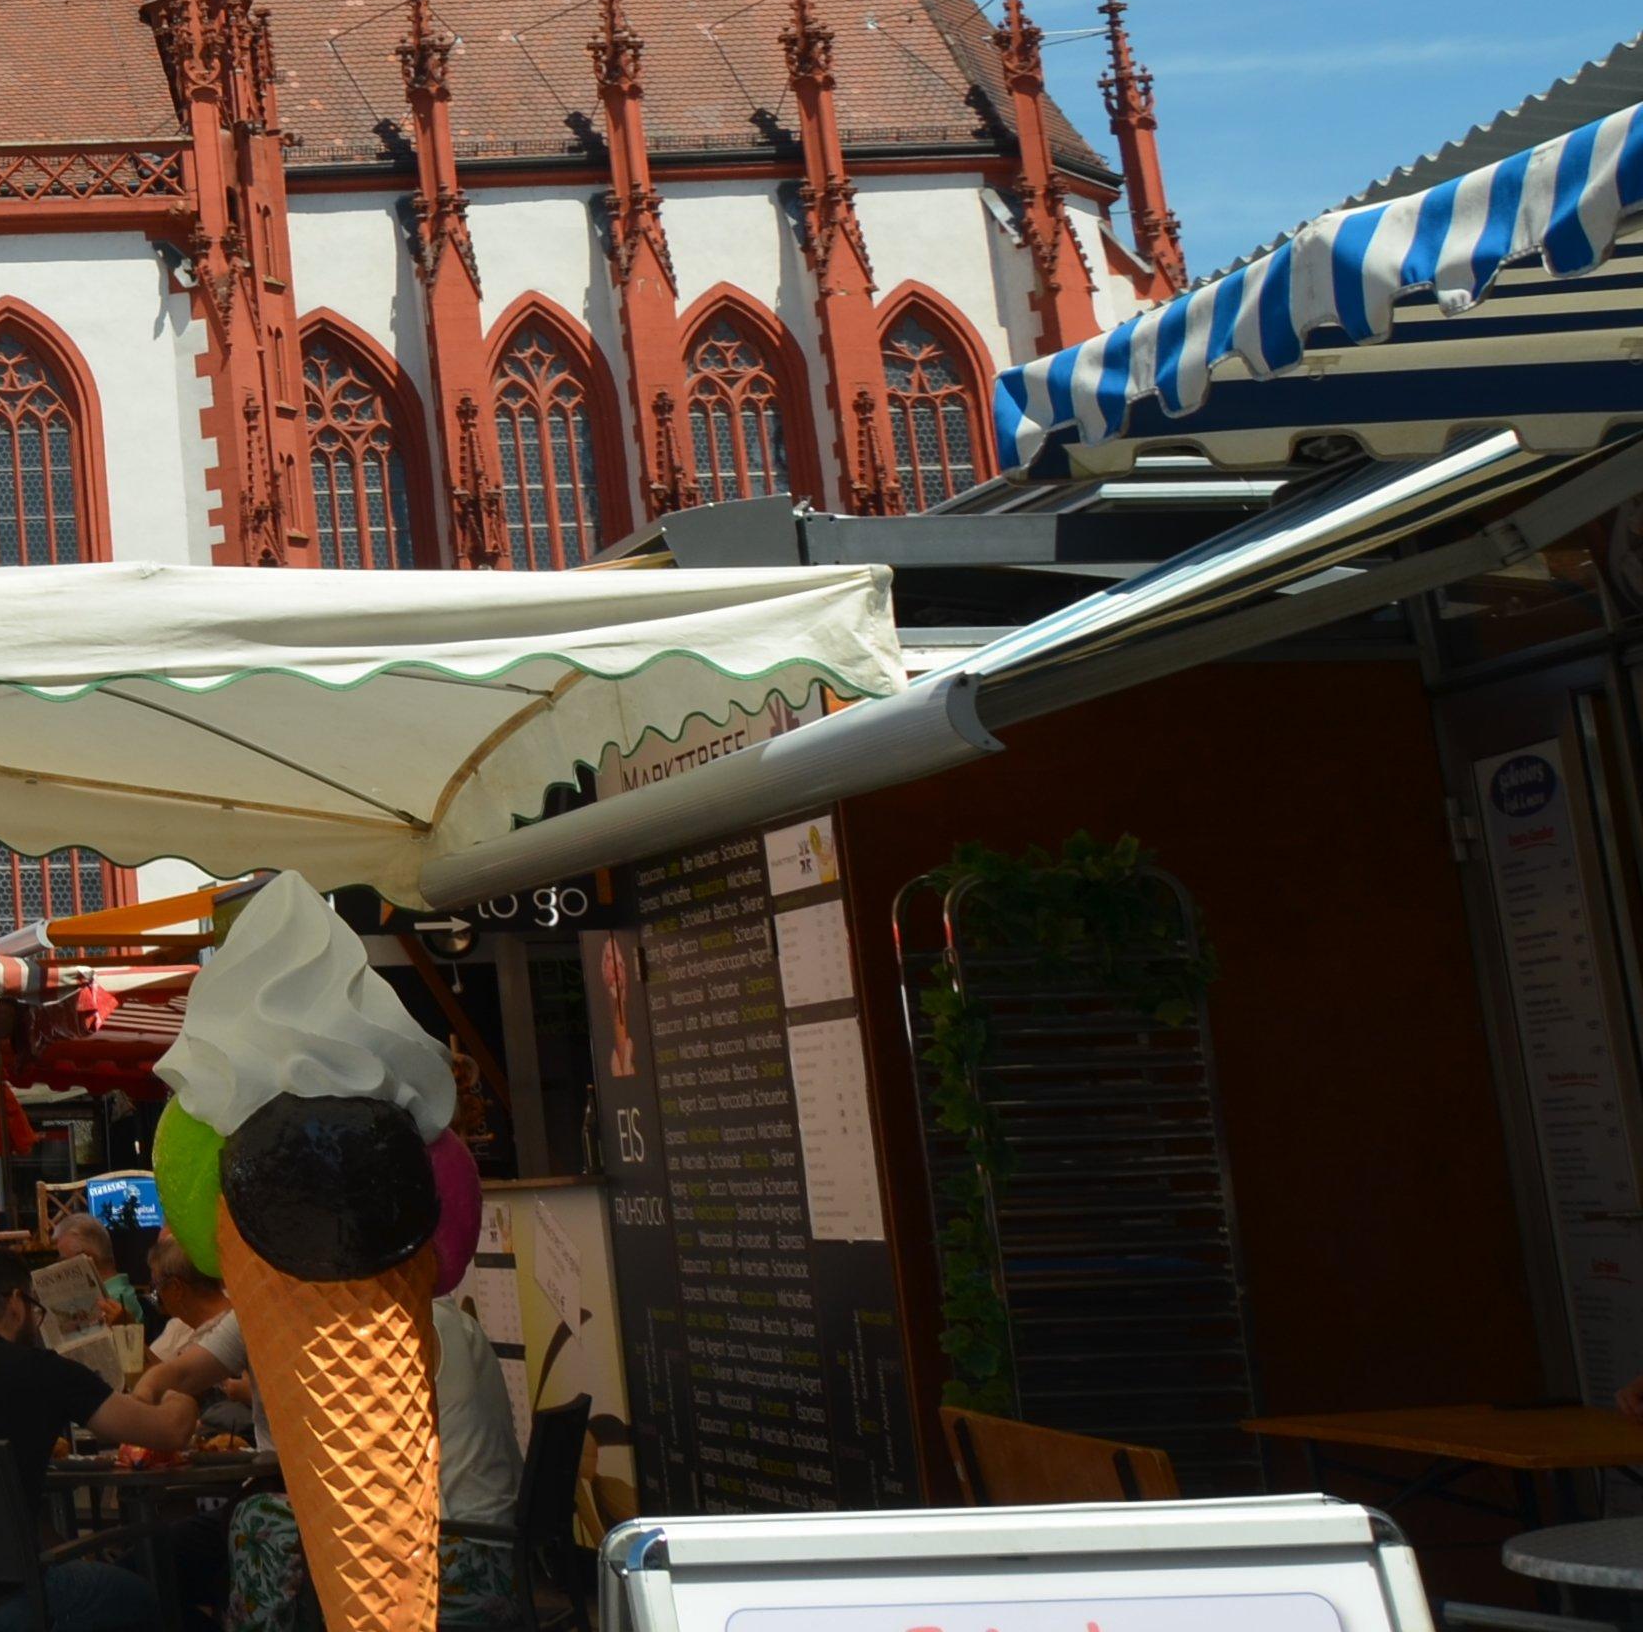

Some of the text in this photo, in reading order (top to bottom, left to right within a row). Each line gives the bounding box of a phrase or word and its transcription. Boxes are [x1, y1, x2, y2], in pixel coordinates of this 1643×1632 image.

[533, 887, 588, 927] go
[617, 1107, 644, 1162] EIS
[615, 1190, 666, 1226] FRÜHSTÜCK
